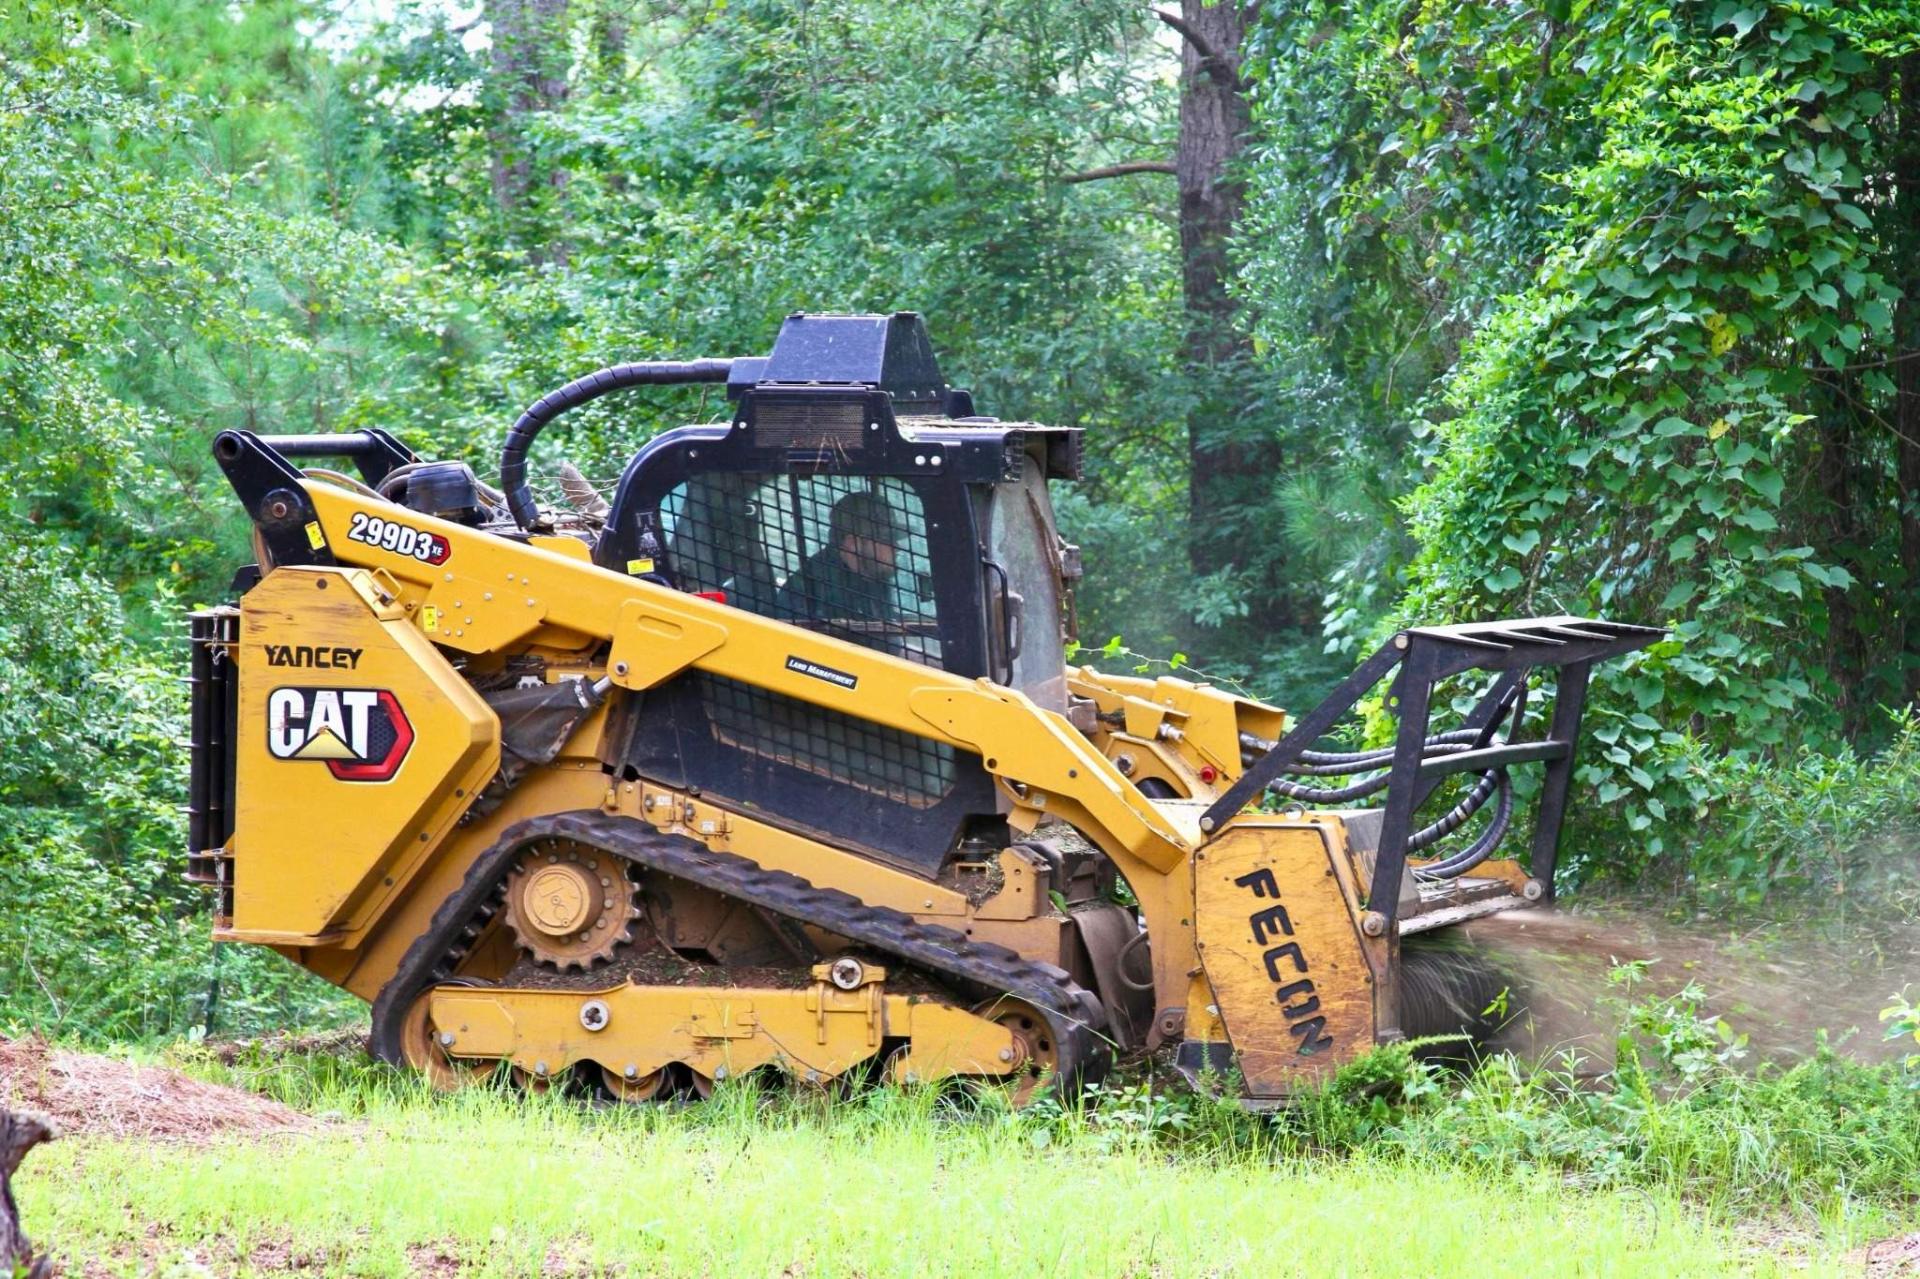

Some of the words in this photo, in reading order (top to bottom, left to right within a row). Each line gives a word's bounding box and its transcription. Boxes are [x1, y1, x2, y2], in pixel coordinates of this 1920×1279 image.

[348, 512, 433, 560] 299D3
[431, 544, 444, 557] XE
[264, 644, 364, 669] YANCEY
[269, 688, 378, 759] CAT
[1234, 868, 1333, 1055] FECON
